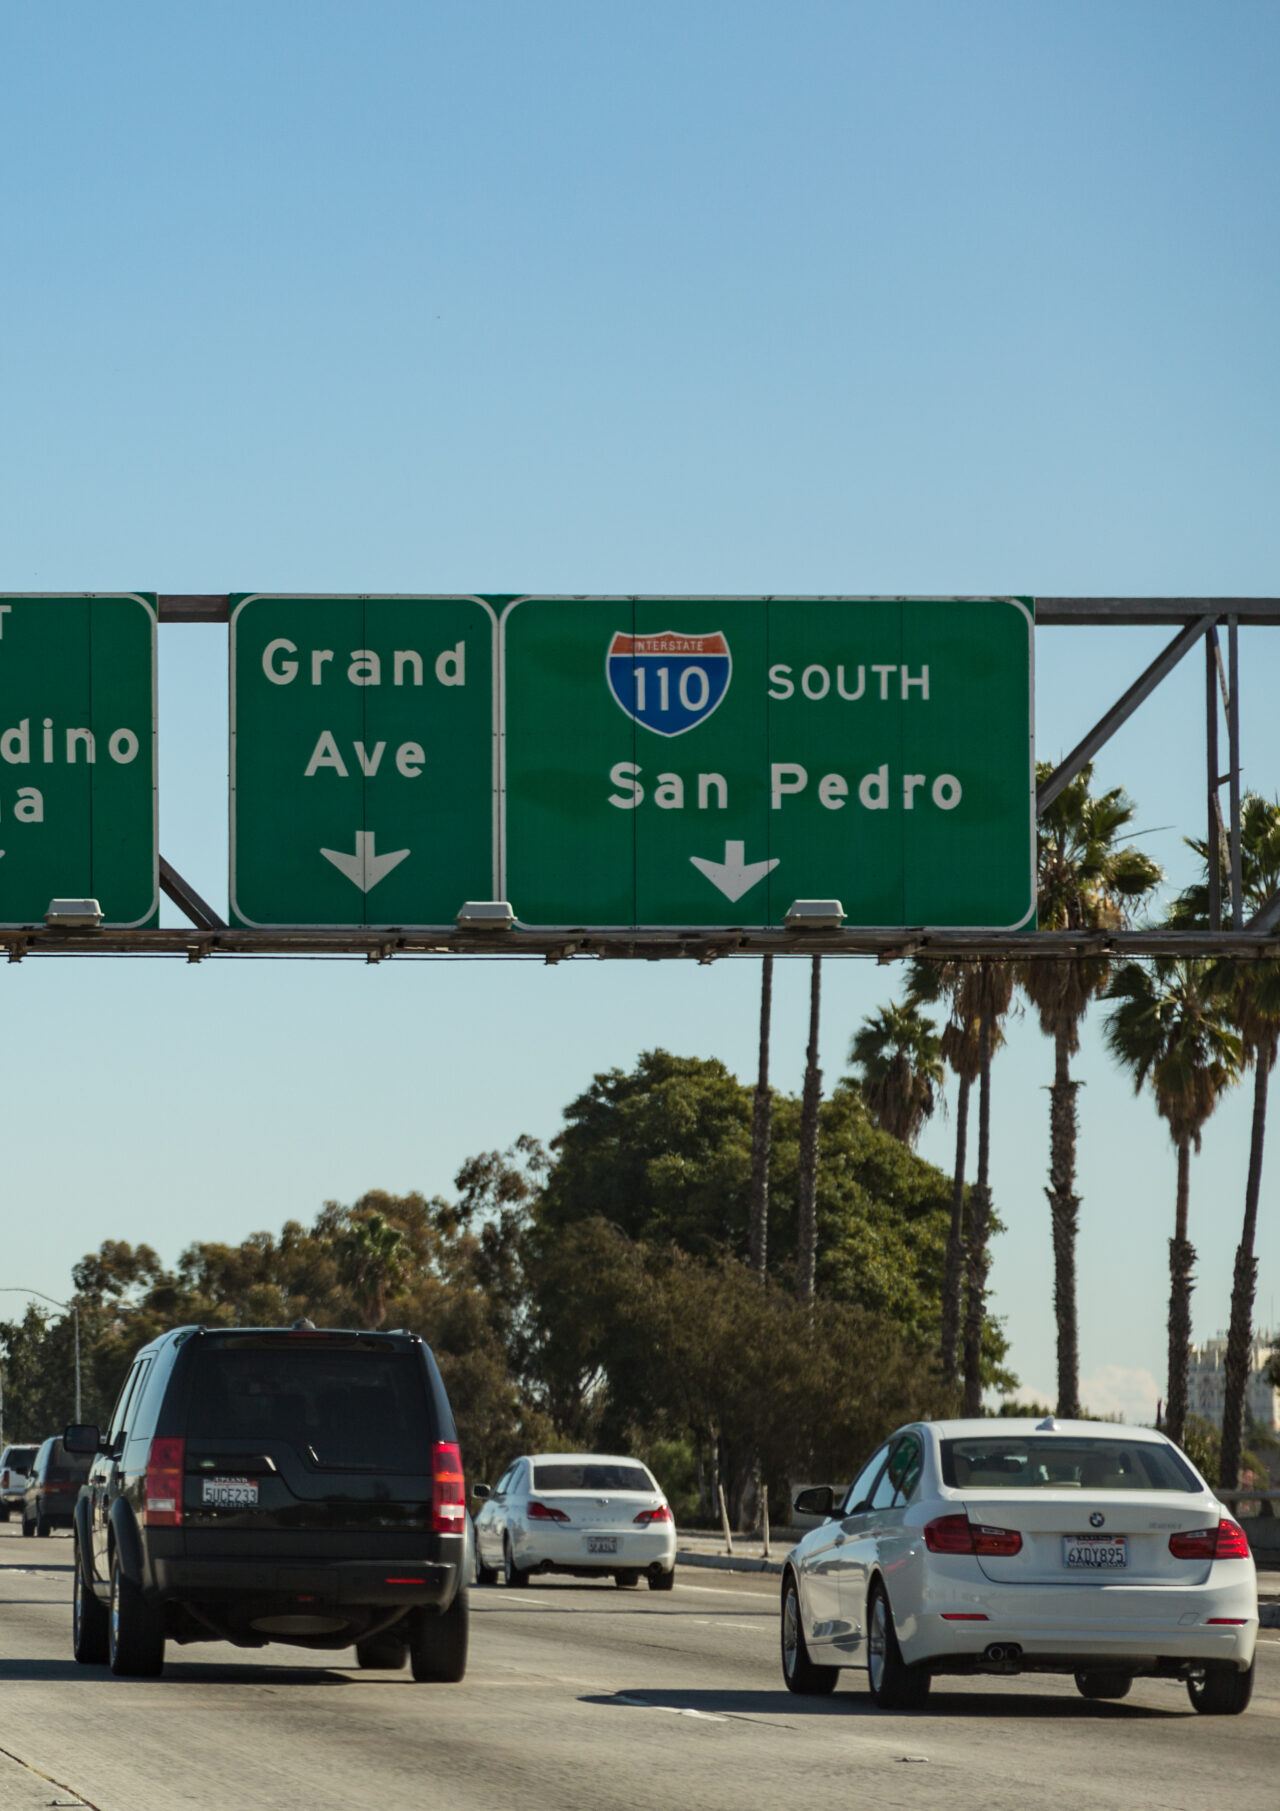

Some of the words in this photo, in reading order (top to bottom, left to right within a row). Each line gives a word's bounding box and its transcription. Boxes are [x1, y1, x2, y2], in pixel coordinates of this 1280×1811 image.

[262, 638, 466, 687] Grand
[768, 663, 931, 702] SOUTH
[633, 665, 710, 711] 110
[304, 731, 427, 778] Ave
[608, 762, 729, 810] San
[770, 763, 963, 811] Pedro
